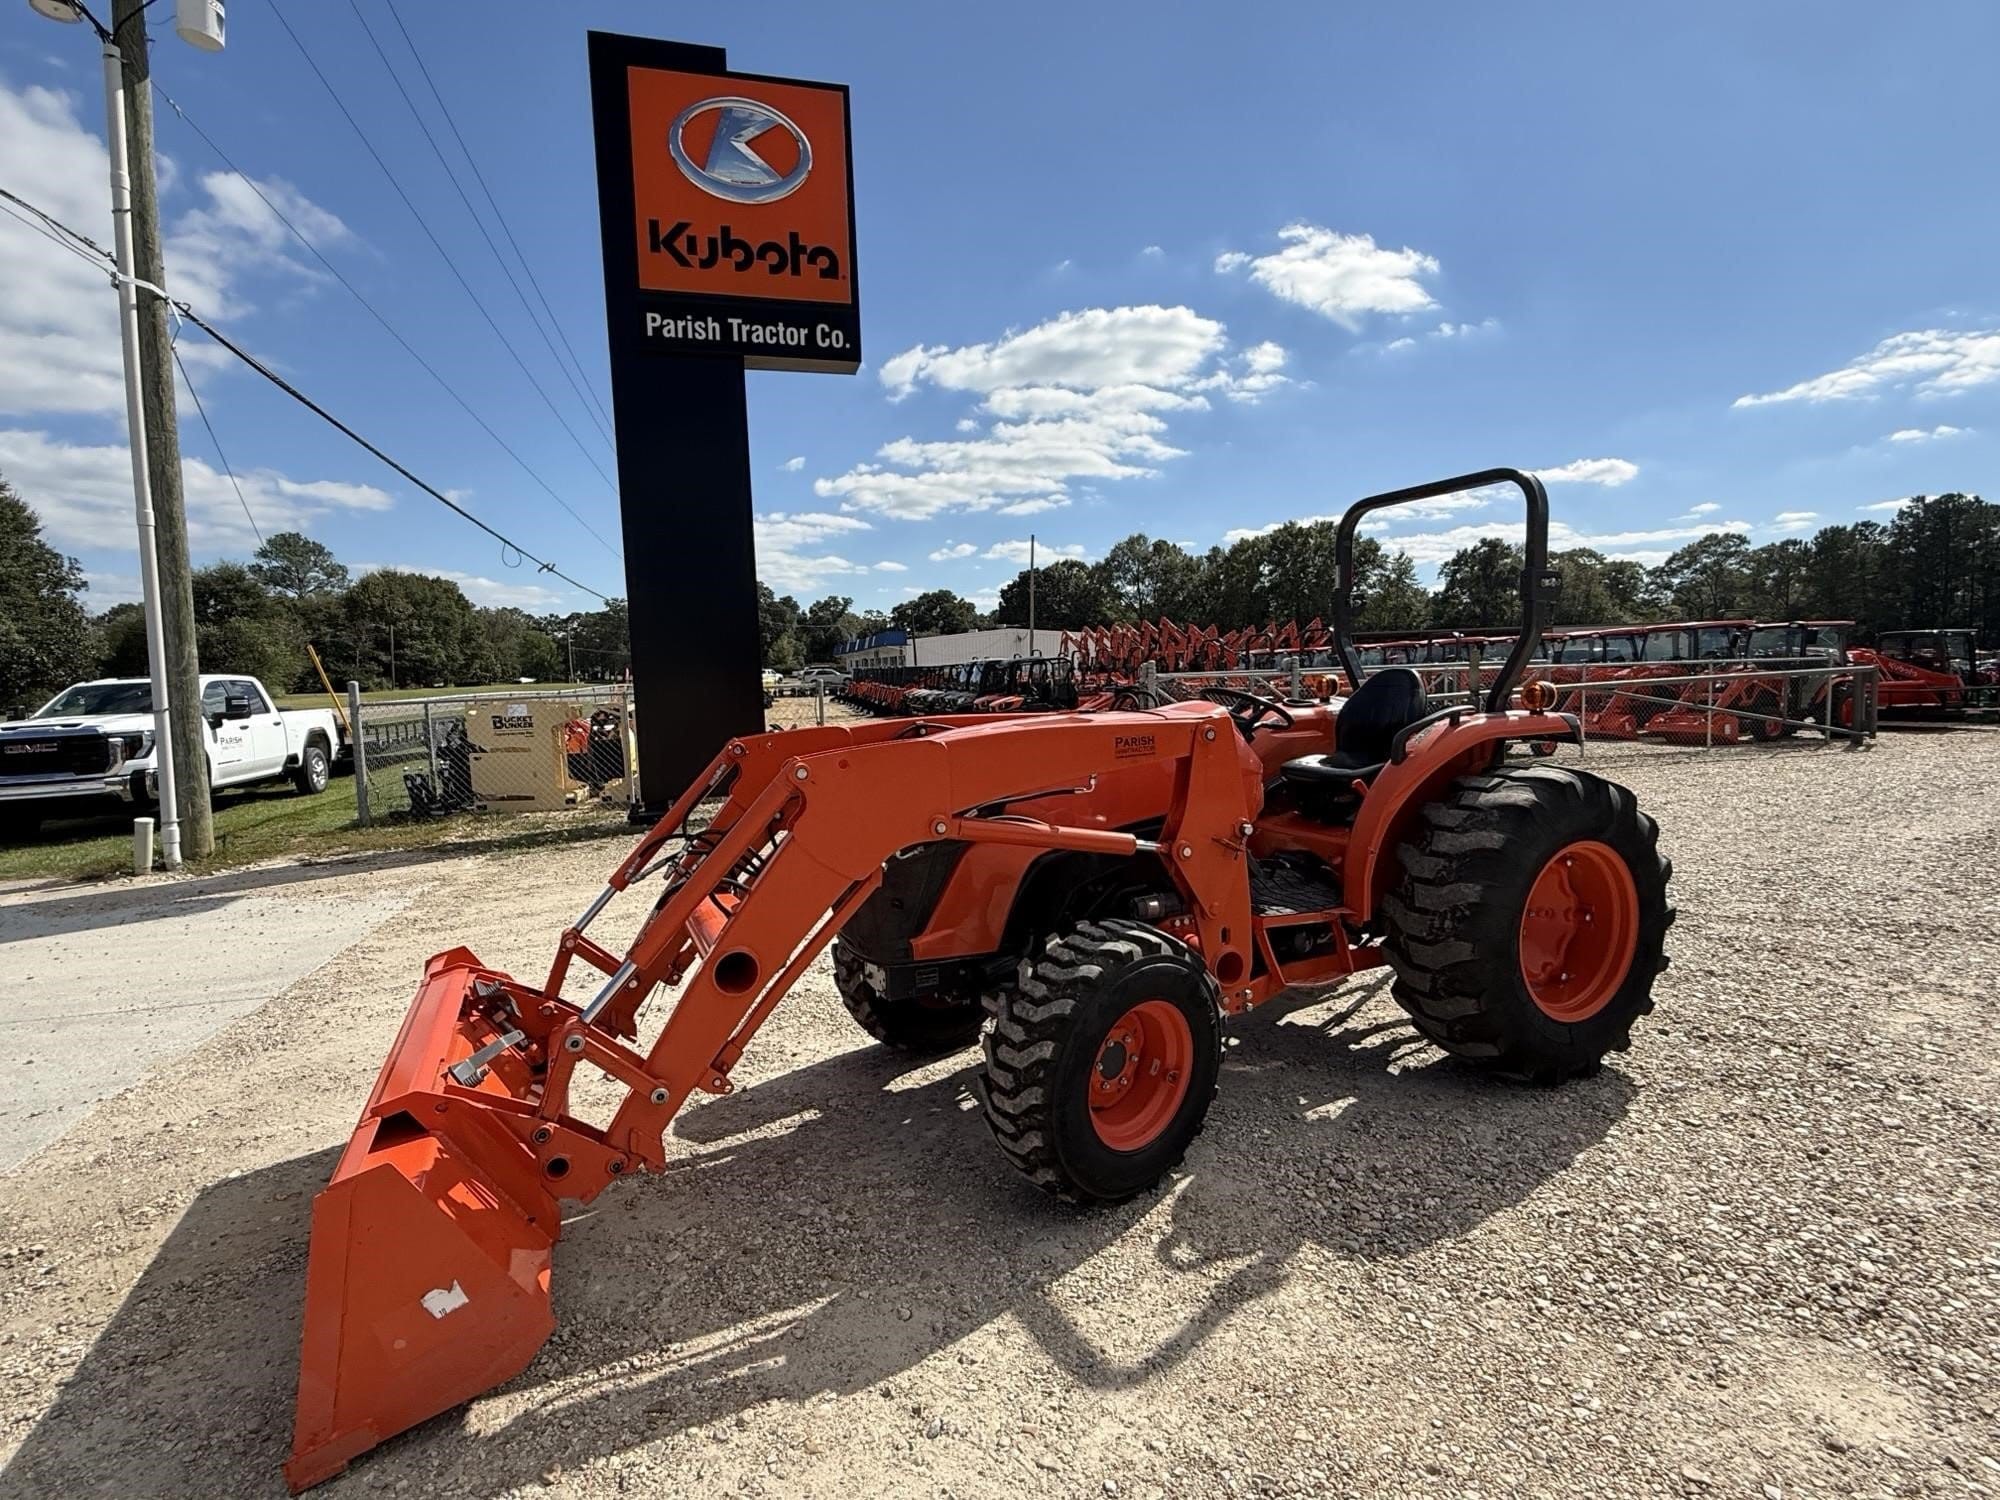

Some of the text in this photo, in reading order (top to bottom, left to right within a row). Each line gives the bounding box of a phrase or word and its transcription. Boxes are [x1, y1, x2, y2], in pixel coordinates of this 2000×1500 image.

[648, 218, 840, 281] Kubota
[646, 312, 851, 349] Parish Tractor Co.
[1115, 735, 1155, 748] PARISH
